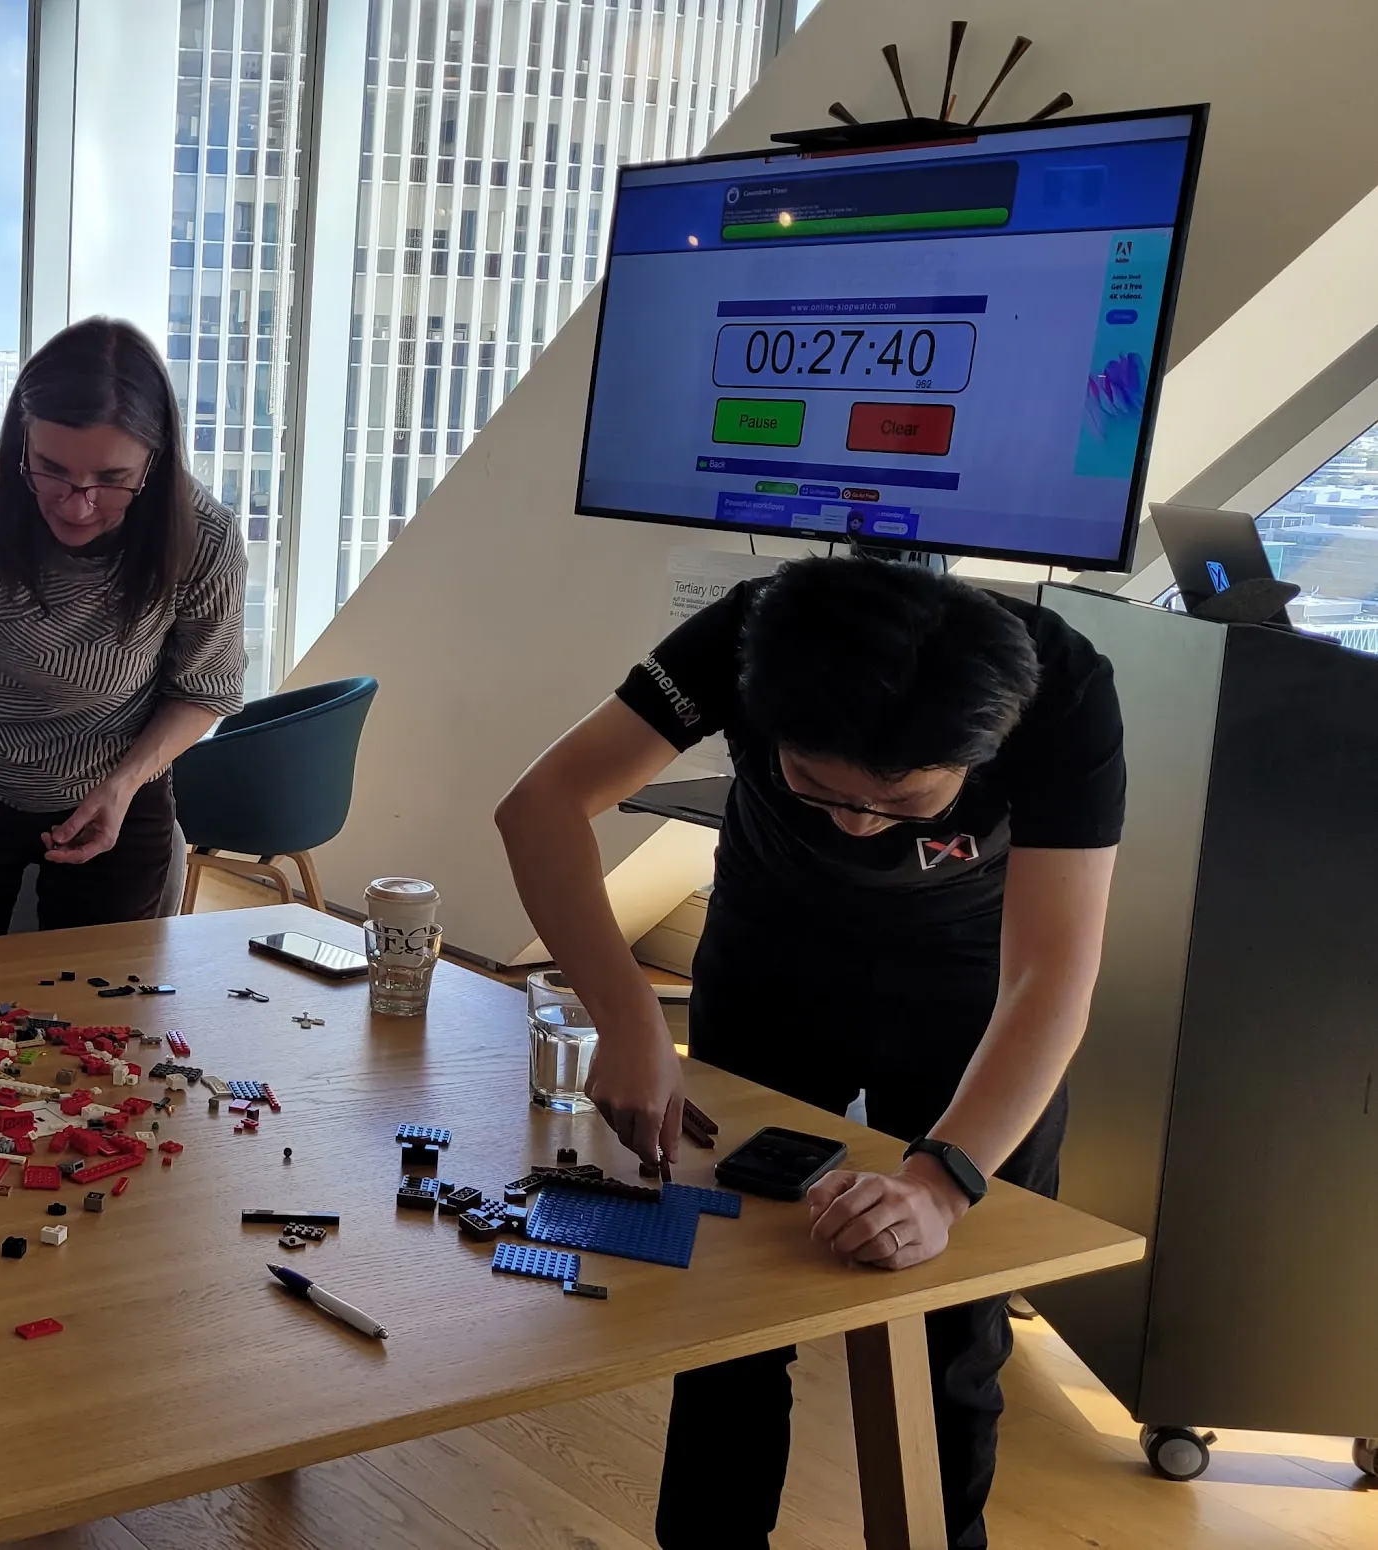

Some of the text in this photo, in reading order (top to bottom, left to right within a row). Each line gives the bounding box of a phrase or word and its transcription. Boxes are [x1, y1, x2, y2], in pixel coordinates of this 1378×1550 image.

[790, 301, 897, 312] www.online-stopwatch.com
[746, 329, 936, 377] 00:27:40
[915, 379, 932, 389] 962
[739, 414, 778, 429] Pause
[880, 420, 920, 436] Clear
[709, 459, 726, 470] Back
[724, 499, 785, 511] Powerful workflows
[675, 580, 727, 598] Tertiary ICT
